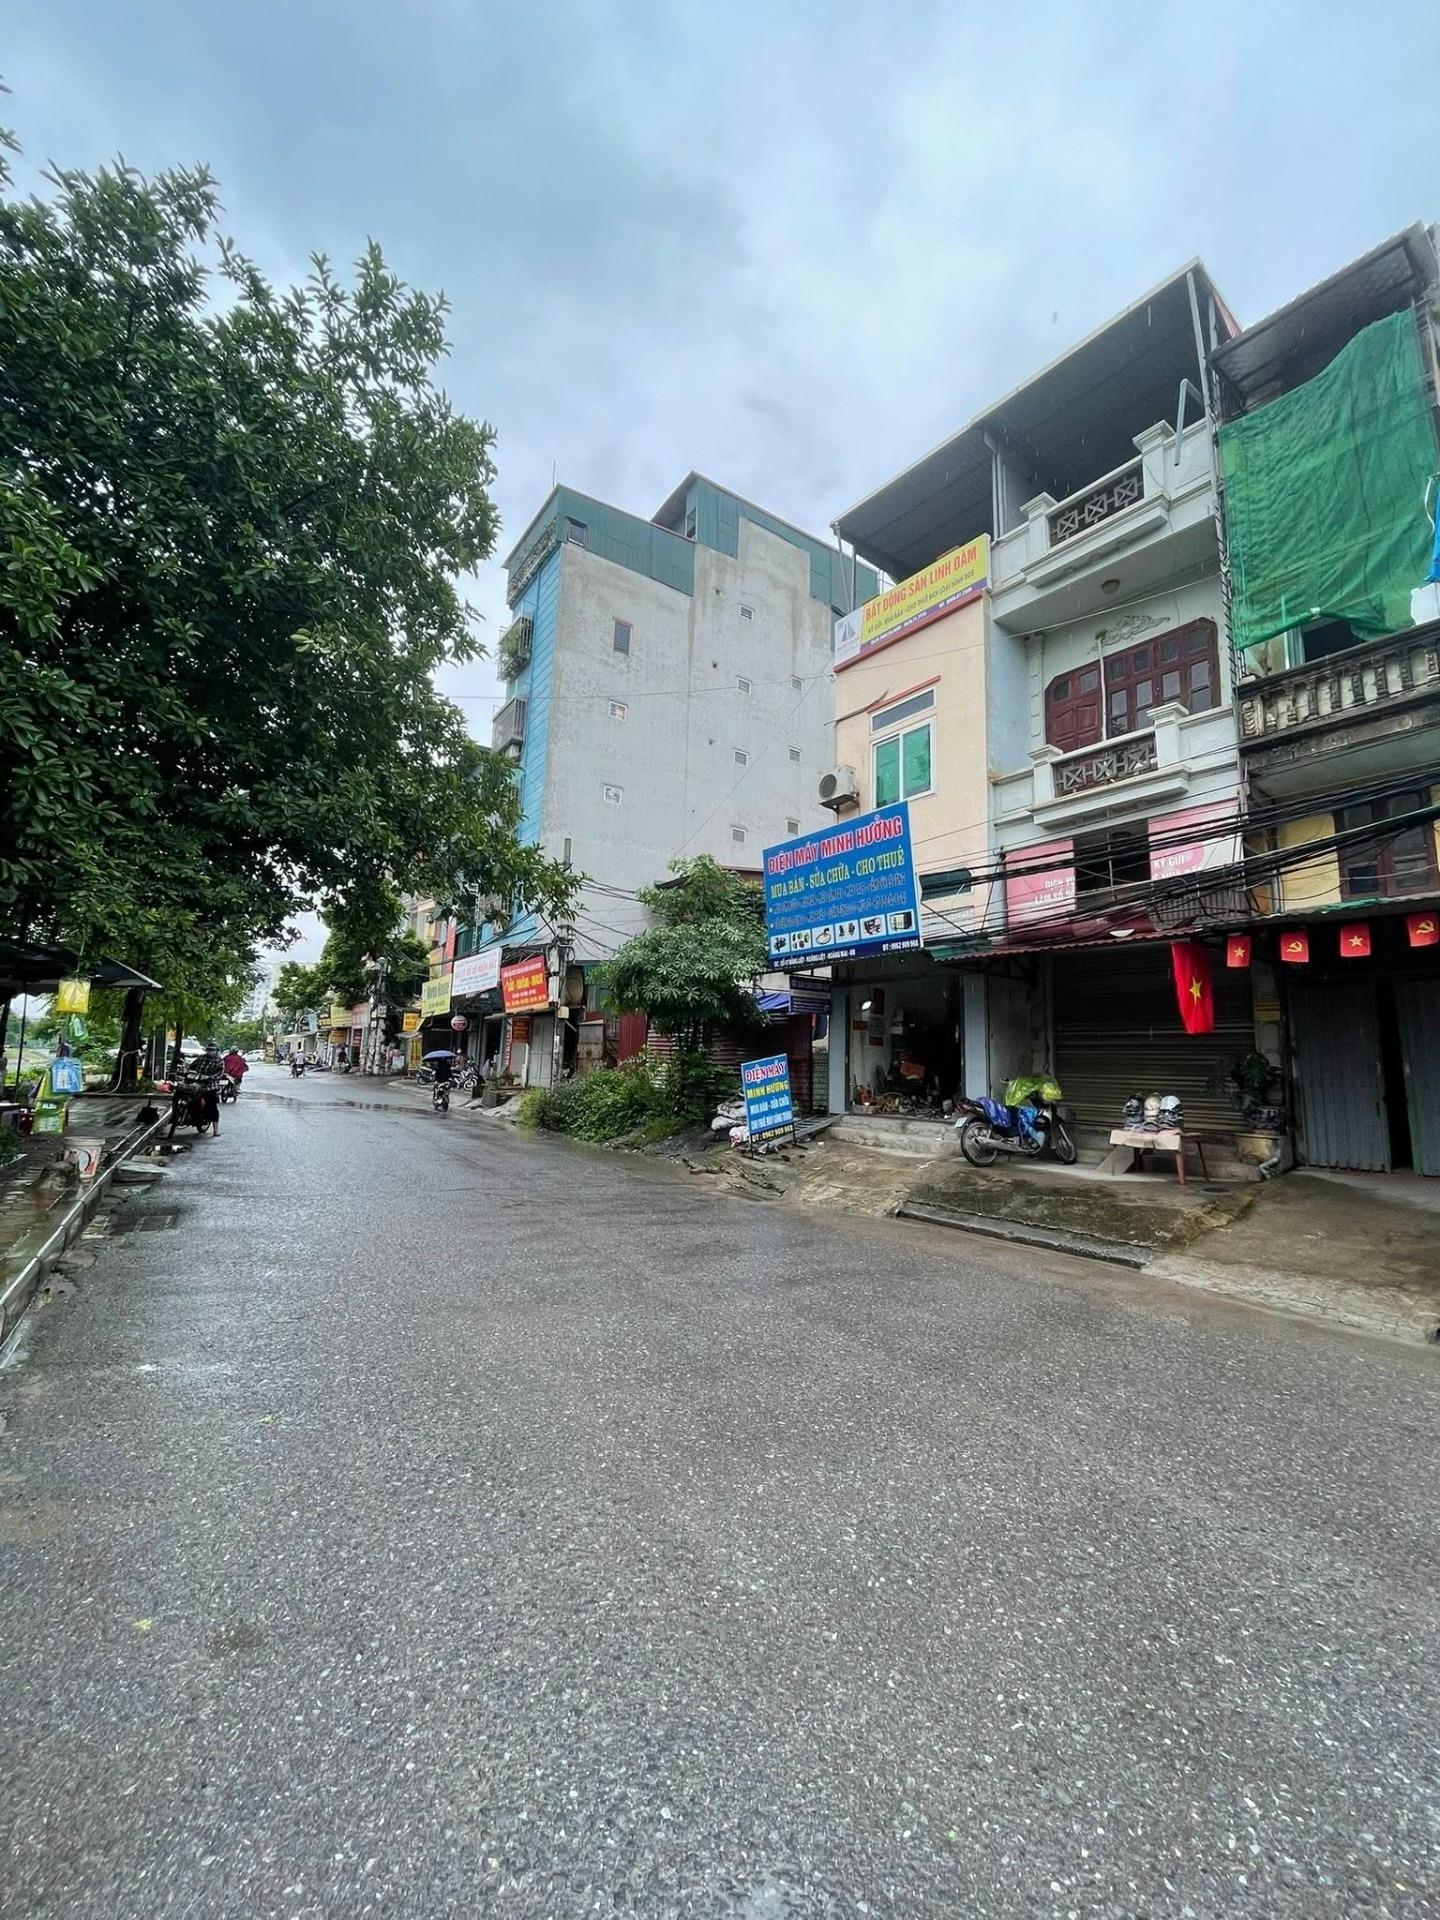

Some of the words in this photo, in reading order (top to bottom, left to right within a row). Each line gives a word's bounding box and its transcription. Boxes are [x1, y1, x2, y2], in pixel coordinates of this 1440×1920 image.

[930, 561, 951, 584] LINH
[794, 841, 820, 866] MÁY
[820, 833, 854, 860] MINH
[771, 882, 788, 899] MUA
[788, 875, 805, 894] BÁN
[856, 857, 875, 876] CHO
[747, 1086, 766, 1099] MINH
